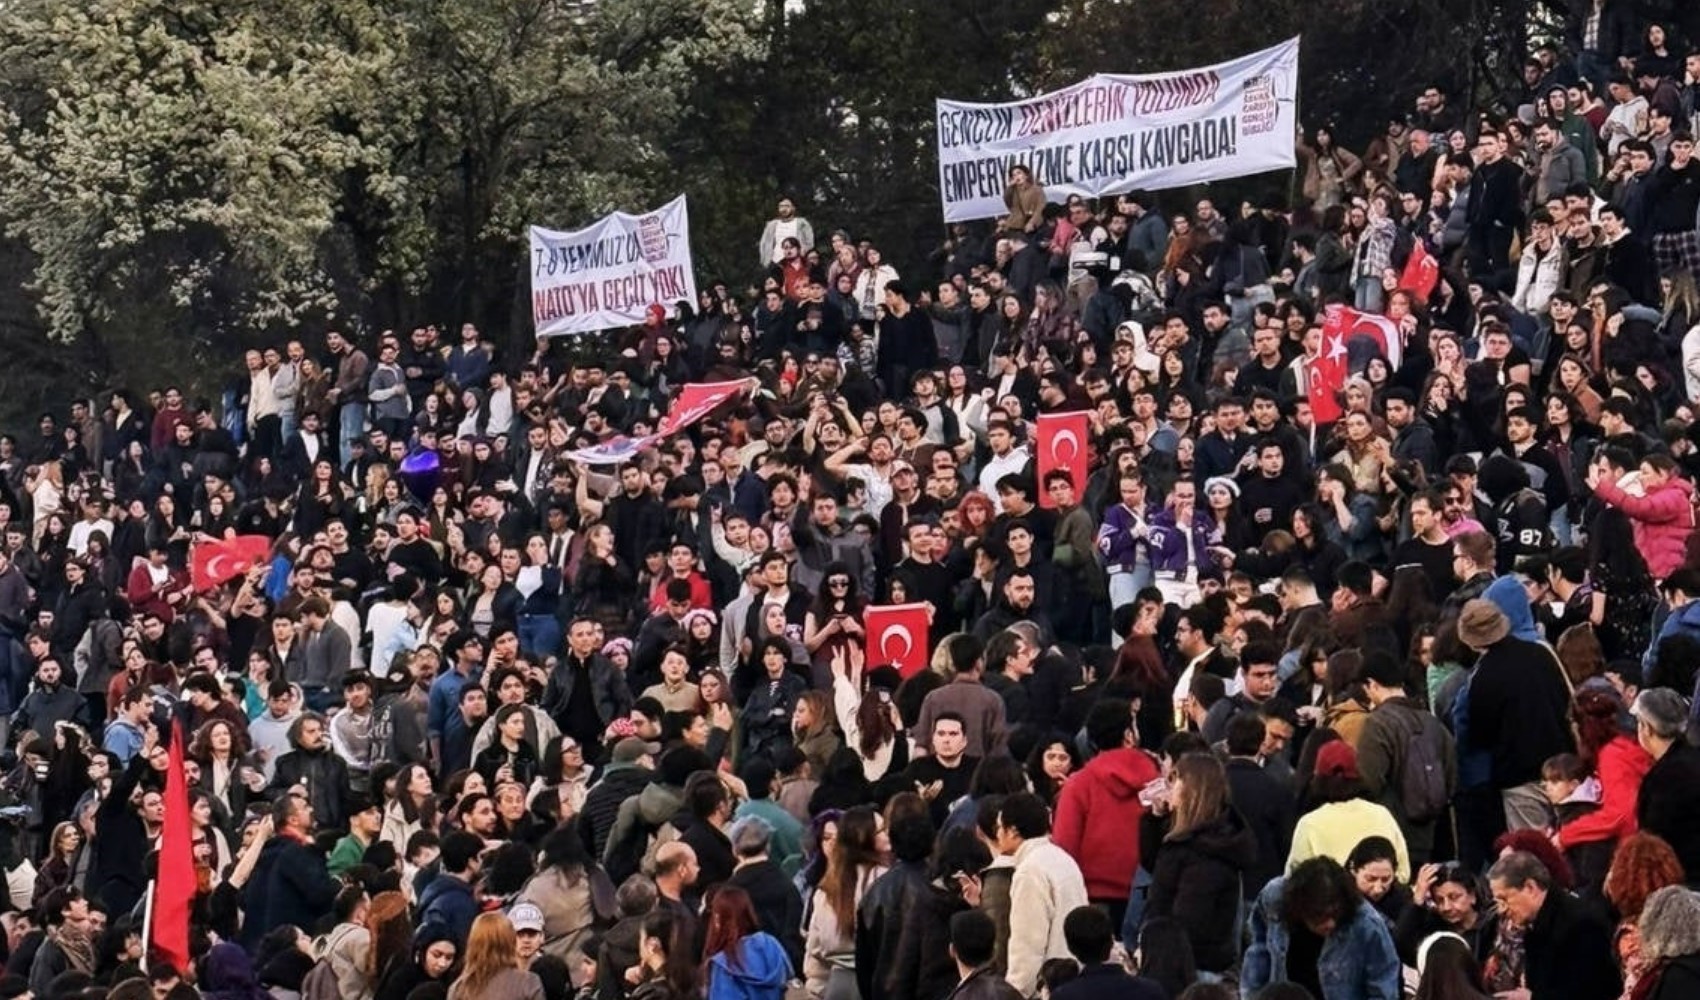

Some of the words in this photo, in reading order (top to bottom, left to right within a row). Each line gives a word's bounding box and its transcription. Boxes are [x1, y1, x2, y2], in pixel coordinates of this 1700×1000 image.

[1132, 70, 1220, 116] YOLUNDA
[1079, 133, 1135, 181] KARŞI
[1140, 115, 1237, 170] KAVGADA!
[535, 247, 558, 276] 7-8
[559, 231, 645, 274] TEMMUZ'DA
[535, 282, 600, 324] NATO'YA
[603, 269, 646, 313] GEÇİT
[650, 264, 688, 303] YOK!
[1520, 529, 1543, 547] 87
